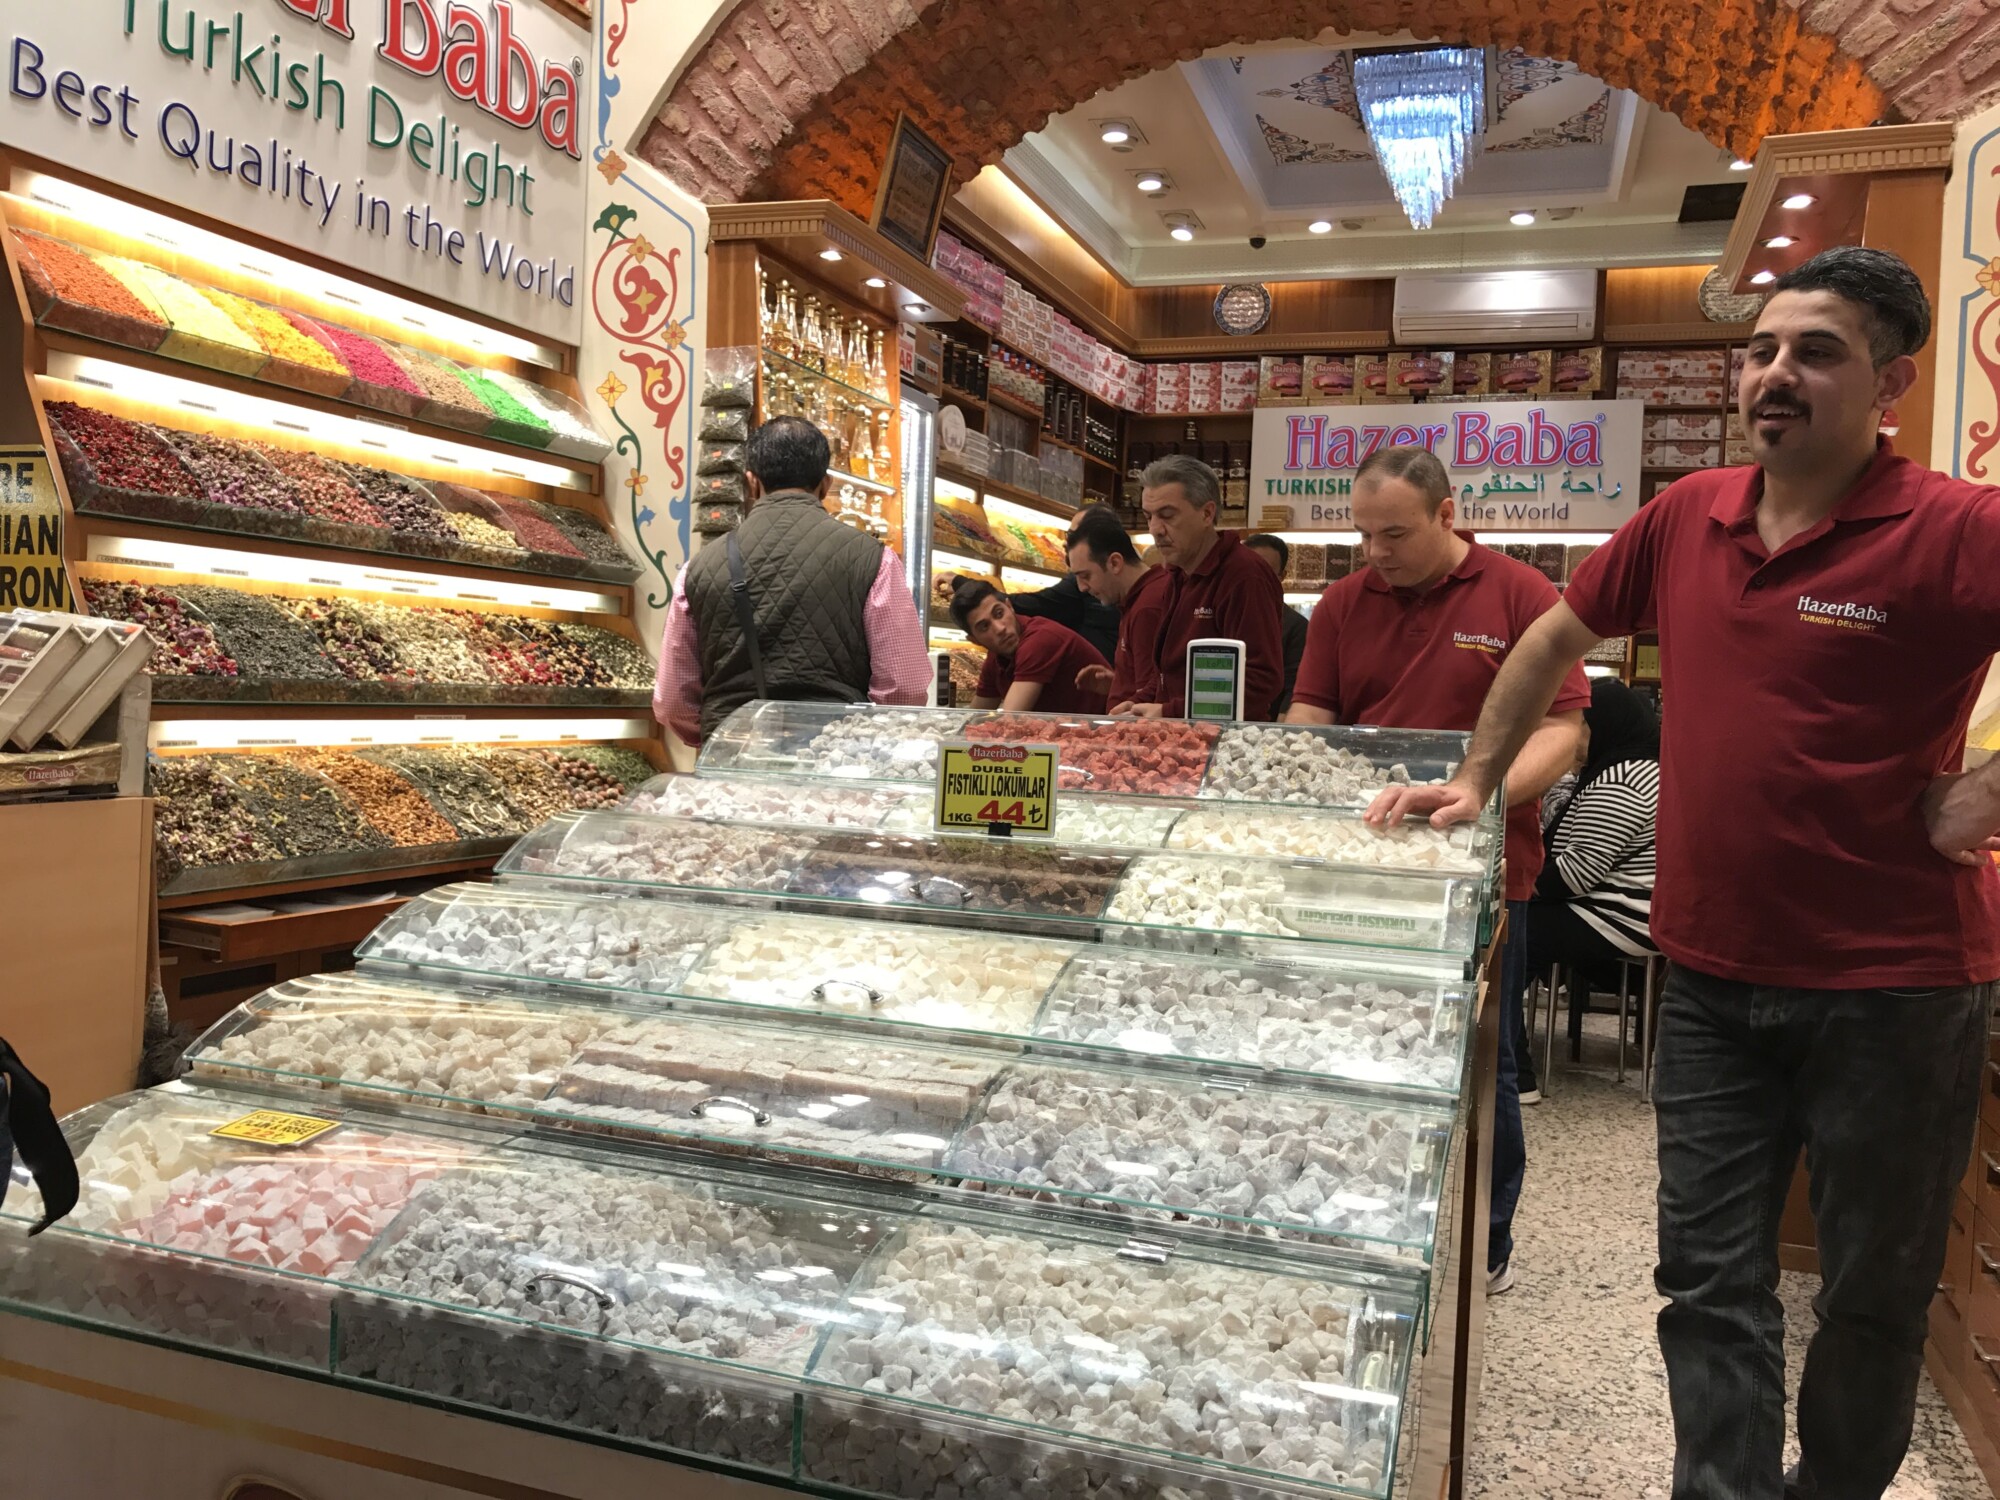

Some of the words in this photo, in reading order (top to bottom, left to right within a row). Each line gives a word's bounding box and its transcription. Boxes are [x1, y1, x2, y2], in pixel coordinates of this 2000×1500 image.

[367, 85, 535, 216] Delight
[10, 36, 140, 139] Best
[158, 101, 341, 228] Quality
[355, 178, 391, 237] in
[405, 204, 466, 266] the
[476, 230, 575, 309] World
[1452, 408, 1603, 467] Baba
[1265, 478, 1350, 496] TURKISH
[1461, 472, 1545, 501] الحلقوم
[1561, 471, 1621, 499] راحة
[1311, 504, 1351, 521] Best
[1463, 502, 1496, 520] the
[1503, 502, 1569, 520] World
[0, 514, 59, 555] IAN
[1797, 596, 1887, 623] HazerBaba
[1799, 613, 1835, 625] TURKISH
[1837, 619, 1876, 632] DELIGHT
[1453, 632, 1506, 649] HazerBaba
[973, 747, 1023, 759] HazerBaba
[29, 768, 75, 780] HazerBaba
[972, 765, 1023, 774] DUBLE
[947, 773, 989, 796] FISTIKLI
[991, 775, 1045, 798] LOKUMLAR
[948, 813, 972, 822] 1KG
[1296, 910, 1354, 927] DELIGHT
[1357, 914, 1418, 932] TURKISH
